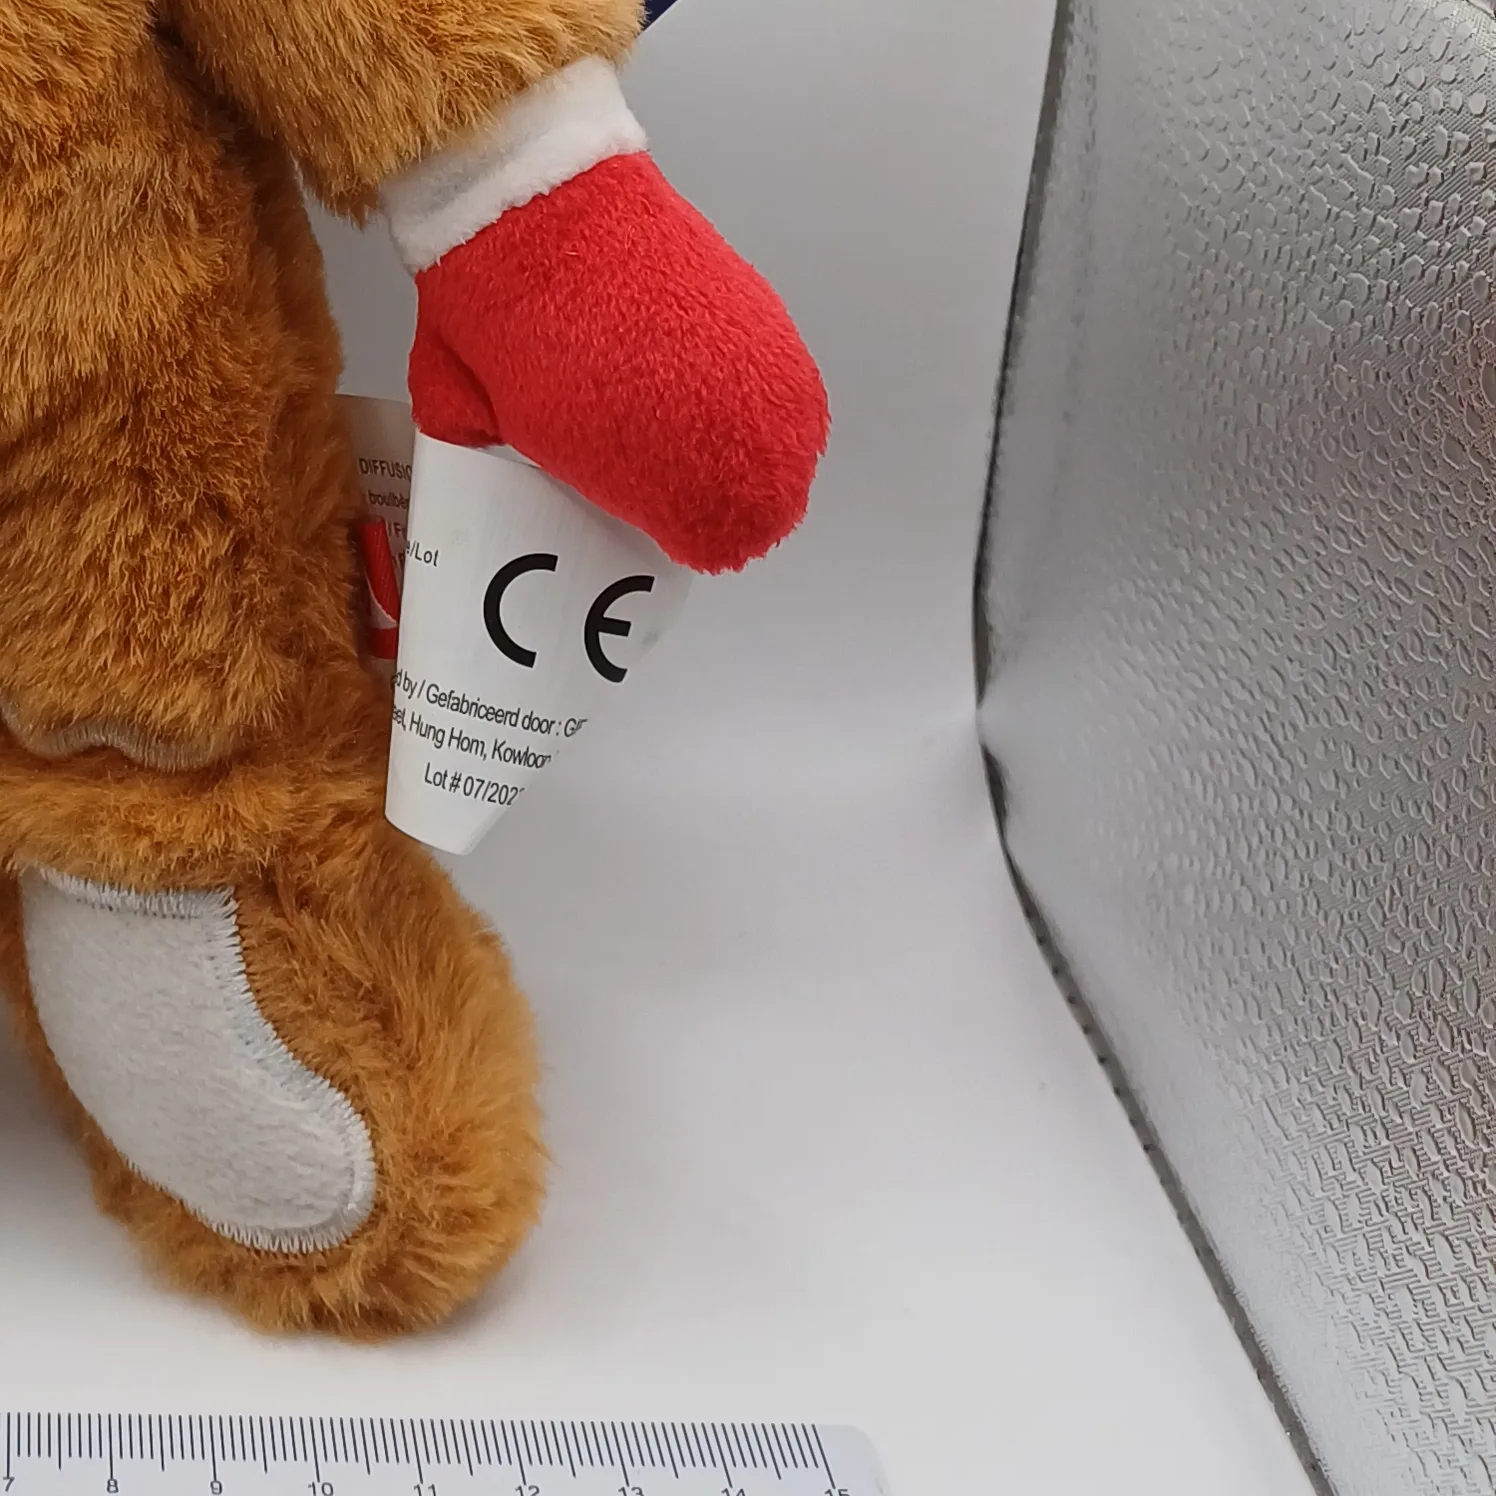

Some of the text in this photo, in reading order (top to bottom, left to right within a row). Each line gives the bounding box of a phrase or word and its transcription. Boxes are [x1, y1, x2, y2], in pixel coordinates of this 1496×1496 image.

[483, 552, 655, 683] CE
[403, 670, 418, 700] by
[426, 683, 521, 728] Gefabriceerd
[409, 711, 446, 750] Hung
[448, 726, 488, 761] Hom,
[424, 762, 525, 806] Lot # 07/202
[2, 1476, 16, 1492] 7
[106, 1478, 120, 1494] 8
[210, 1480, 223, 1495] 9
[307, 1481, 334, 1496] 10
[413, 1483, 437, 1496] 11
[514, 1484, 540, 1496] 12
